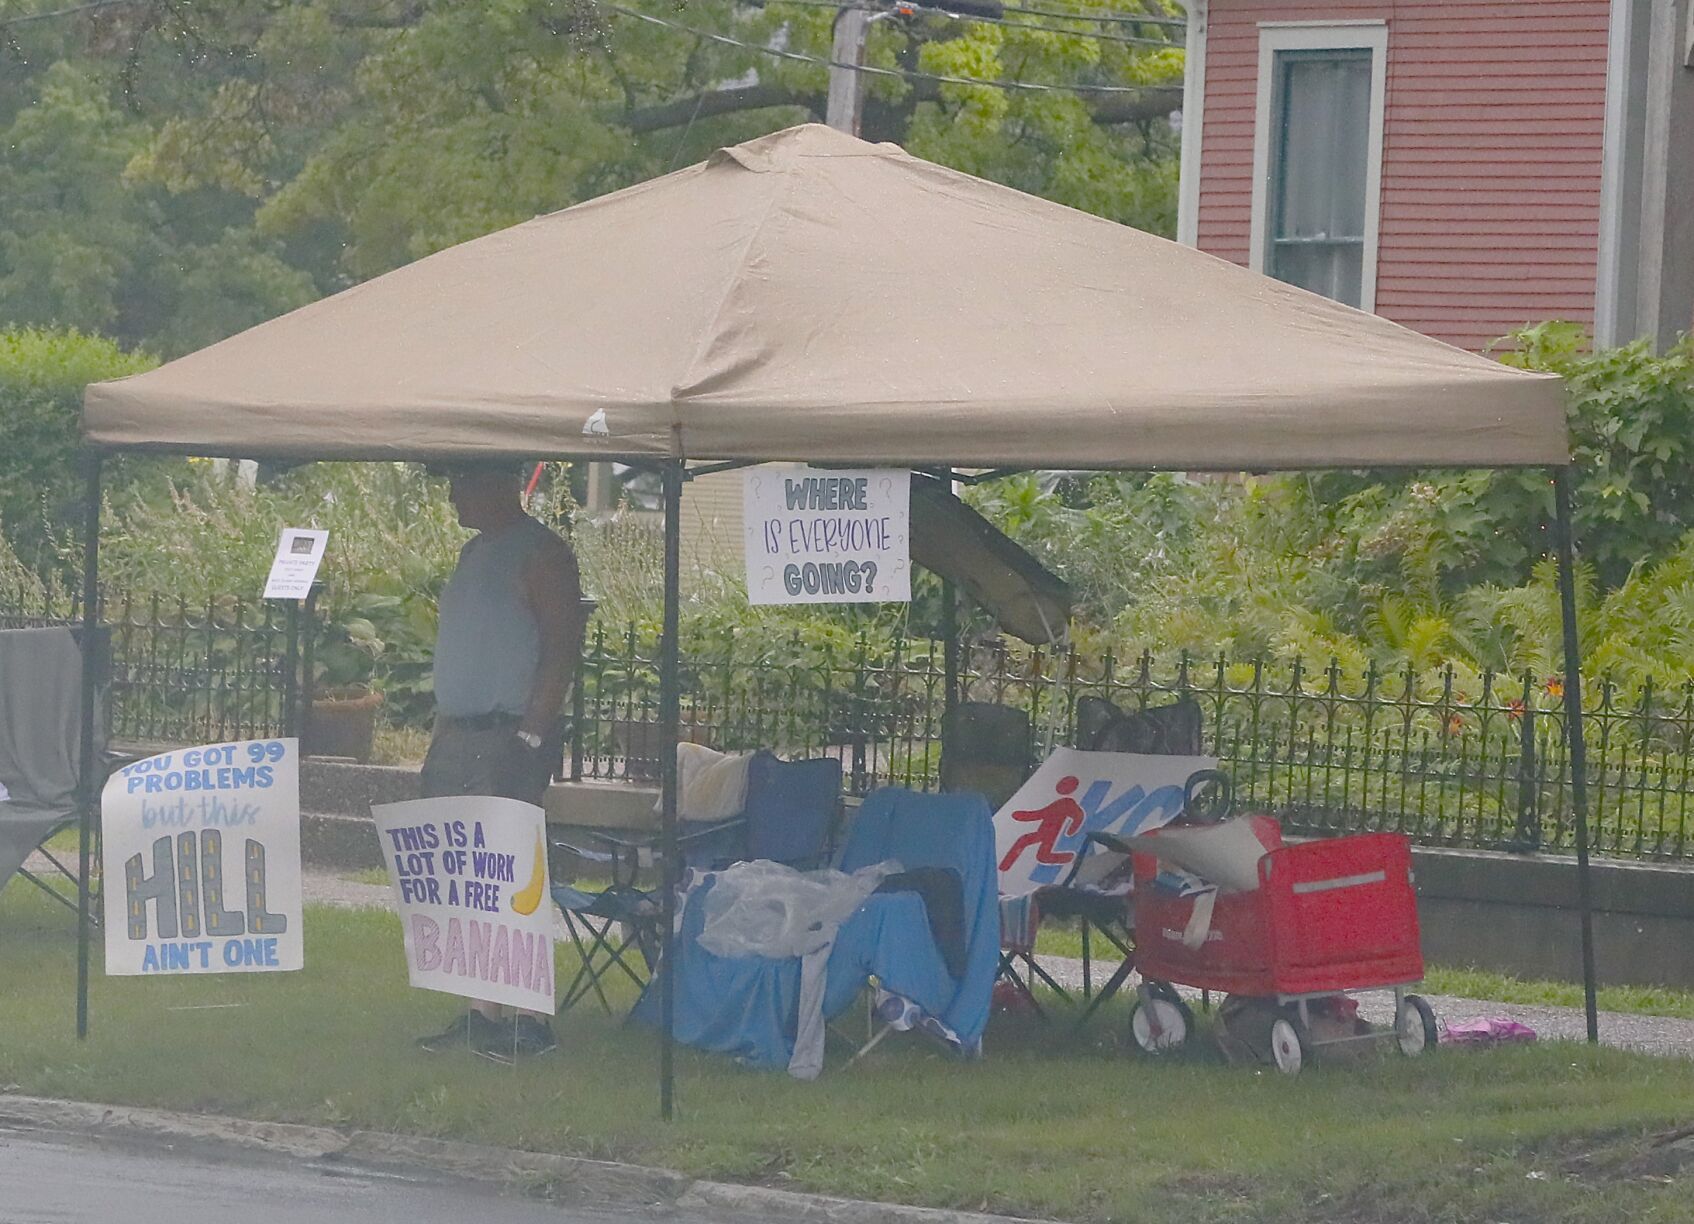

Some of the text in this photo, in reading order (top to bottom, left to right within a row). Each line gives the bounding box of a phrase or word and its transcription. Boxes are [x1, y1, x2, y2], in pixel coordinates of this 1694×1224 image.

[784, 478, 868, 511] WHERE
[764, 517, 891, 554] IS EVERYONE
[783, 560, 878, 597] GOING?
[121, 741, 285, 777] YOU GOT 99
[127, 765, 274, 794] PROBLEMS
[141, 796, 262, 829] but this
[385, 820, 486, 851] THIS IS A
[395, 850, 515, 883] LOT OF WORK
[125, 828, 287, 940] HILL
[399, 878, 500, 913] FOR A FREE
[142, 938, 279, 972] AIN'T ONE
[411, 913, 551, 996] BANANA
